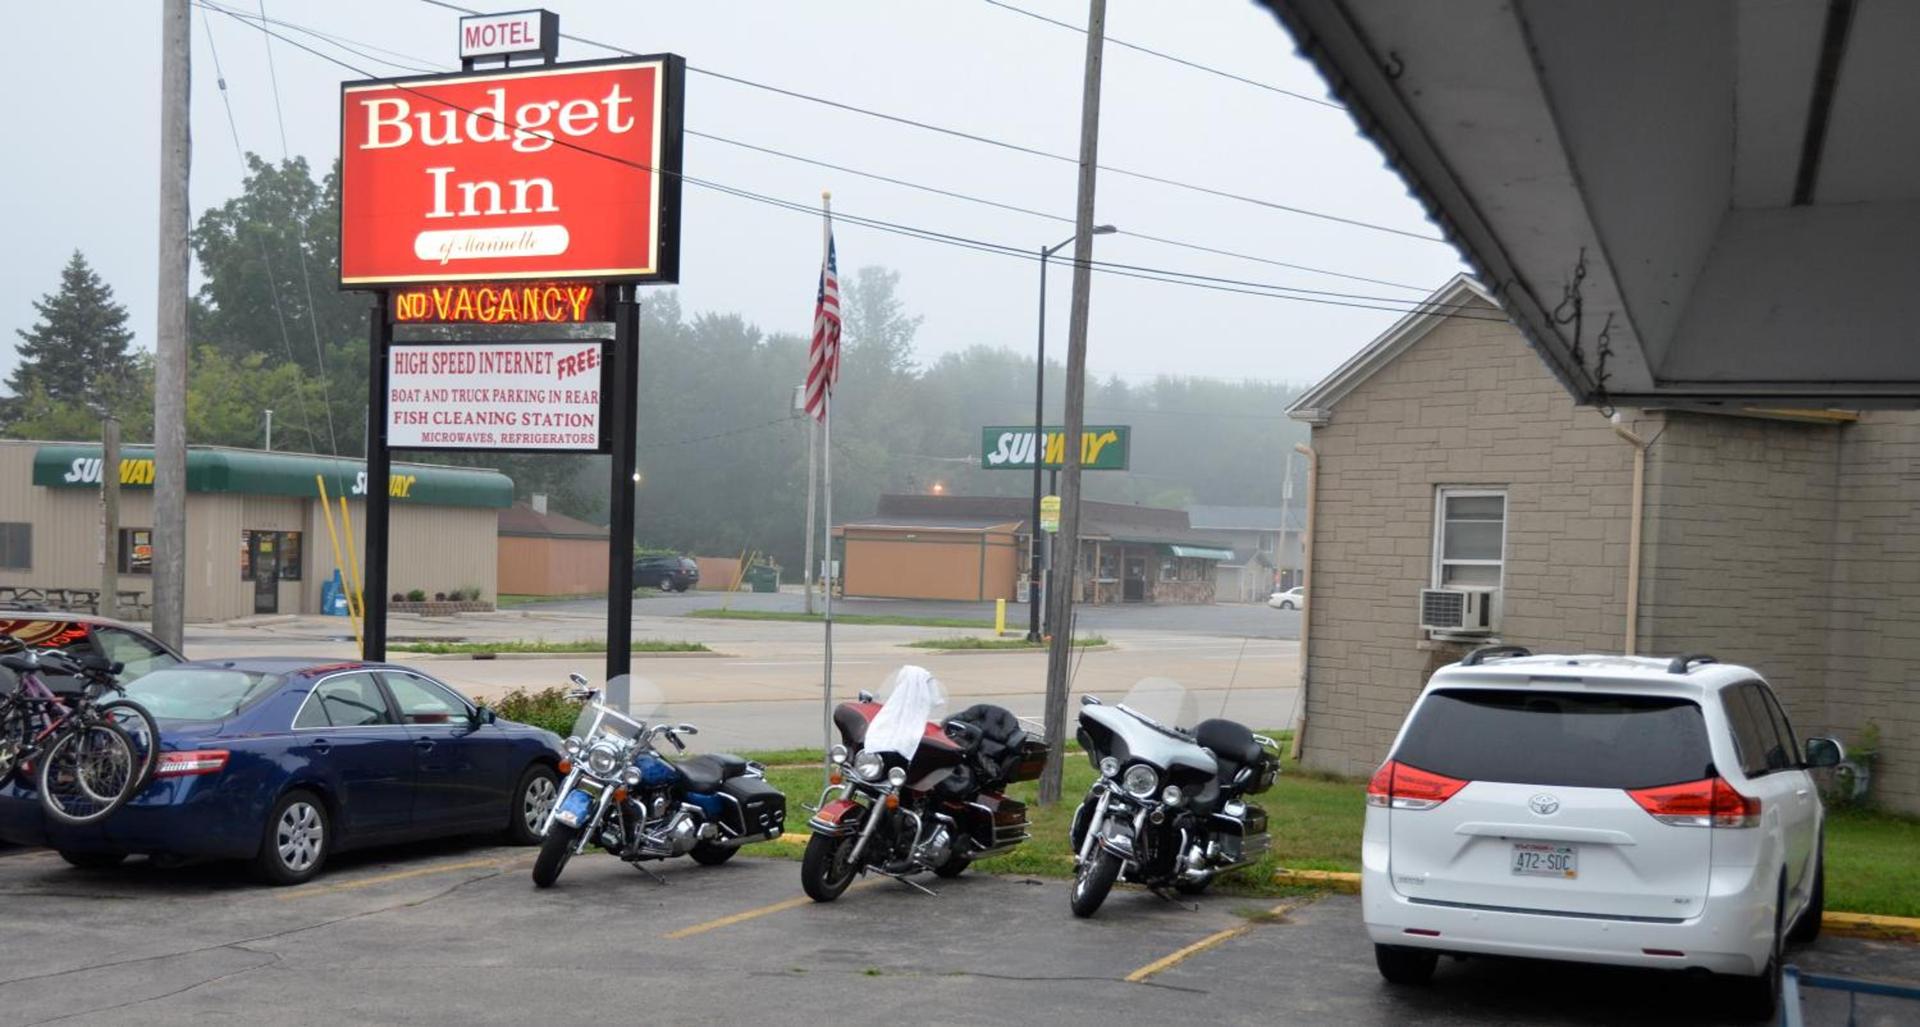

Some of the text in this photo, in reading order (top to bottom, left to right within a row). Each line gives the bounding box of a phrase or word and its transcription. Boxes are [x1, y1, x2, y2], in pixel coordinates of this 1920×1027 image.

[464, 21, 535, 49] MOTEL
[359, 83, 635, 153] Budget
[424, 166, 560, 218] Inn
[439, 235, 455, 265] of
[396, 287, 589, 321] NO VACANCY
[394, 352, 429, 375] HIGH
[431, 351, 476, 375] SPEED
[479, 351, 553, 375] INTERNET
[391, 389, 599, 405] BOAT AND TRUCK PARKING IN REAR
[393, 411, 595, 428] FISH CLEANING STATION
[421, 432, 595, 446] MICROWAVES, REFRIGERATORS
